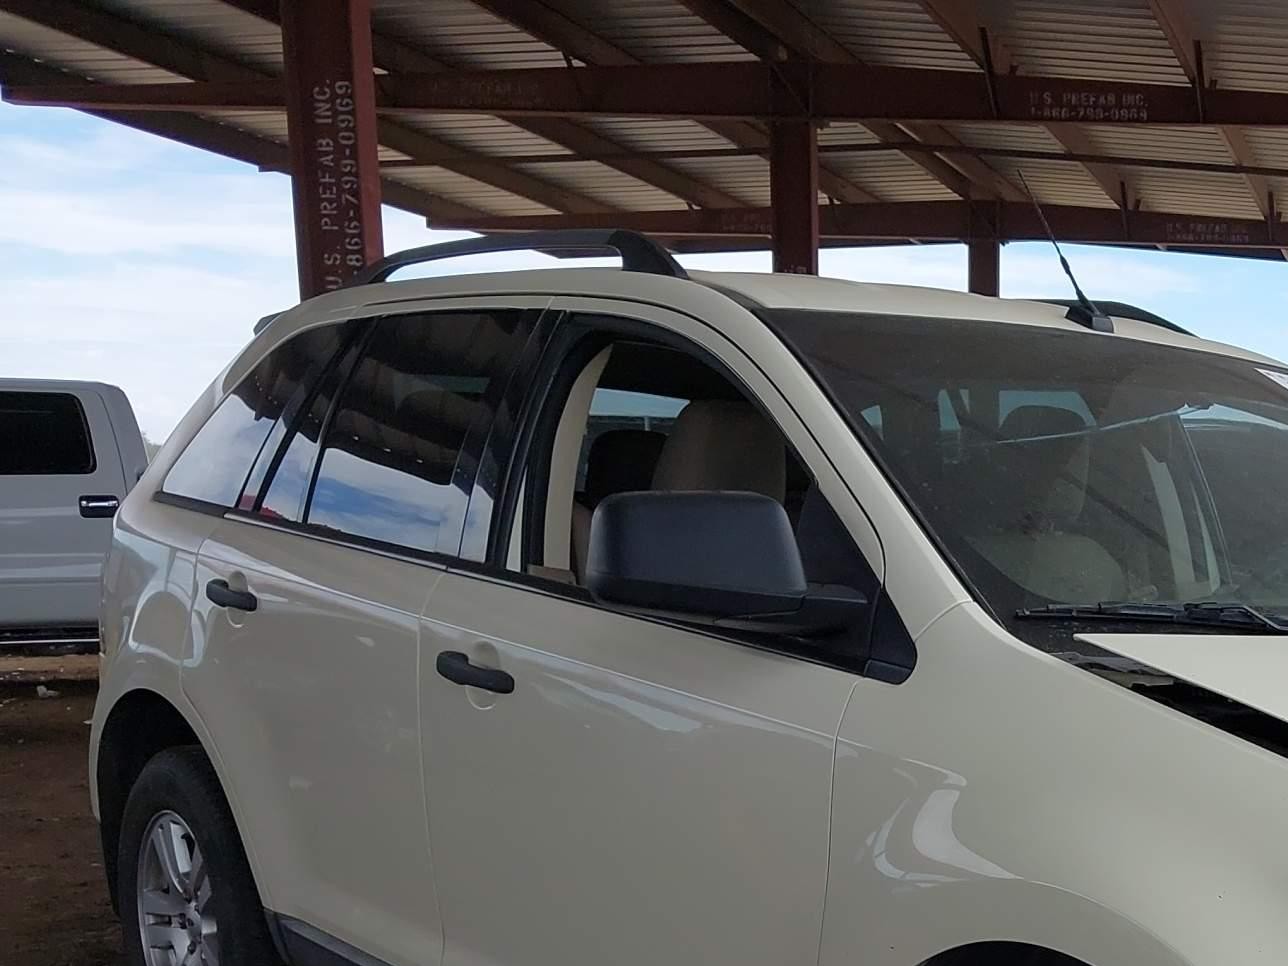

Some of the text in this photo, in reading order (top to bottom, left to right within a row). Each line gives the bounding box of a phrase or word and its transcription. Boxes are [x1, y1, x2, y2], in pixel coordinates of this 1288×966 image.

[313, 79, 343, 289] U.S. PREFAB INC.
